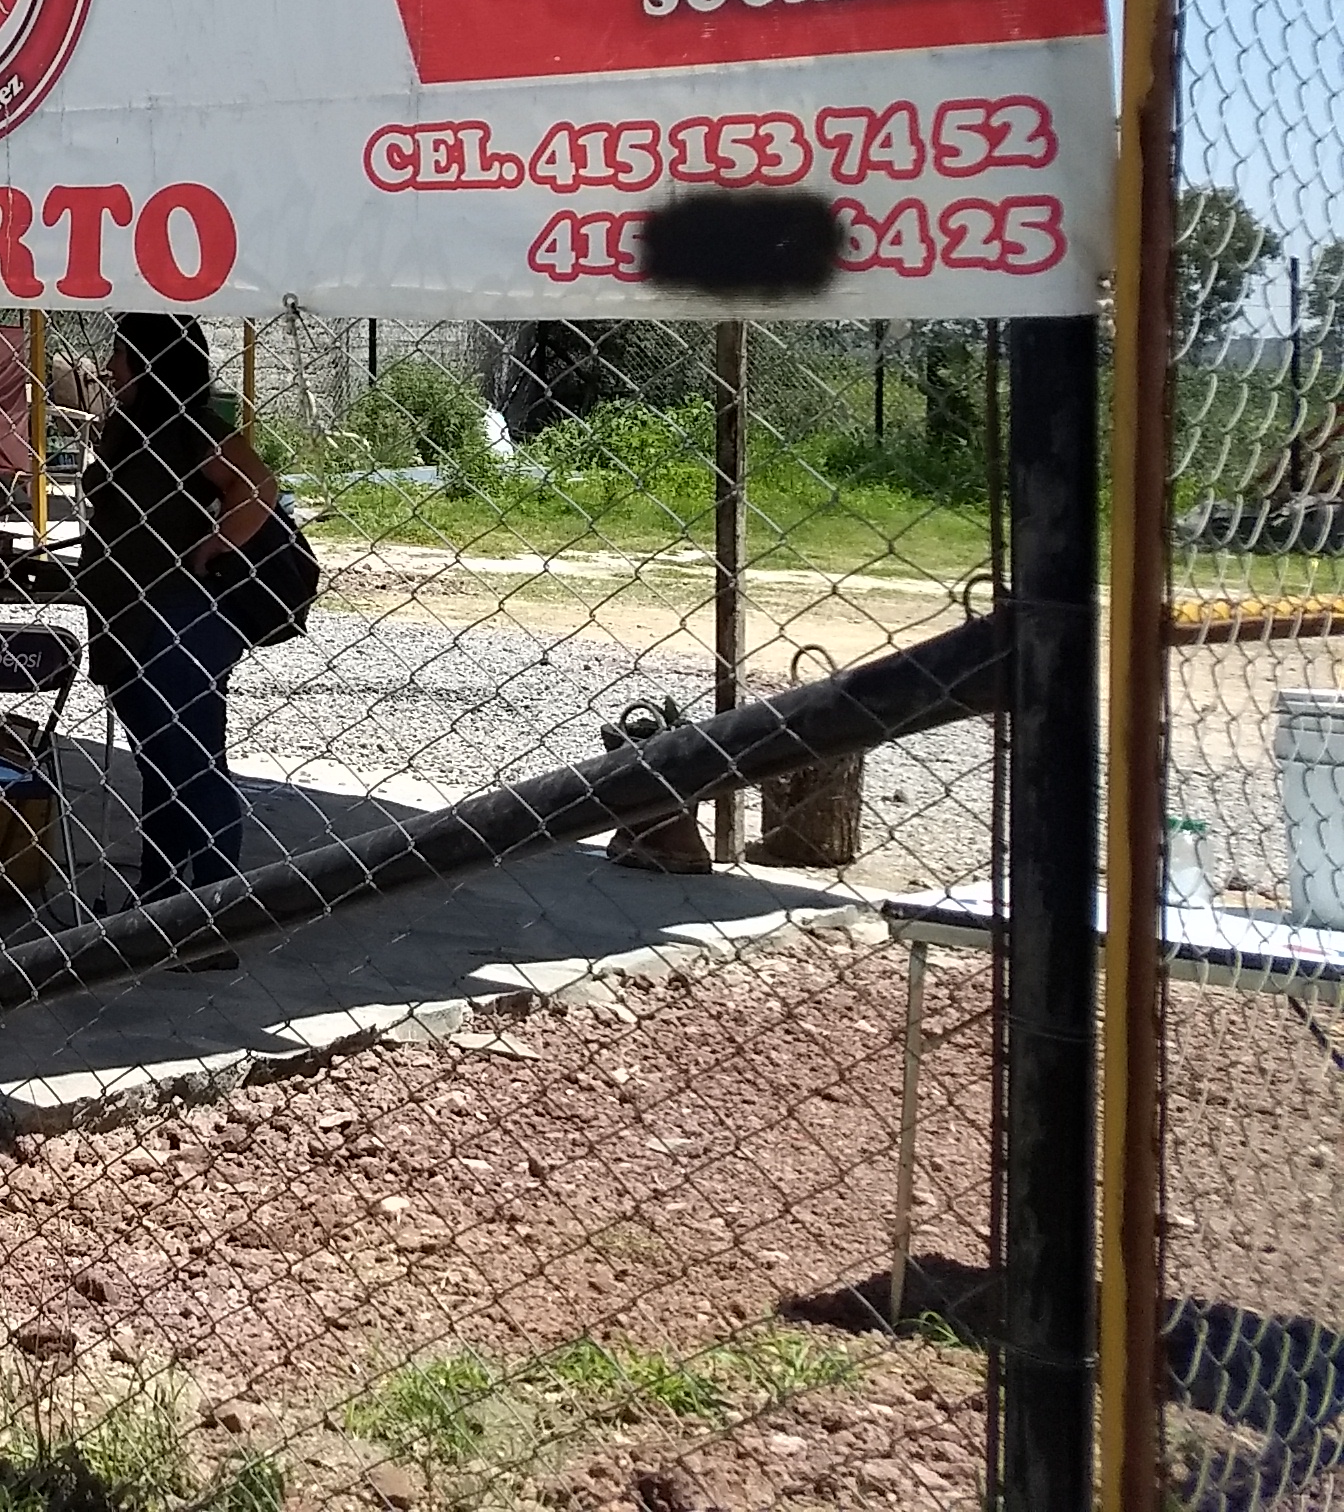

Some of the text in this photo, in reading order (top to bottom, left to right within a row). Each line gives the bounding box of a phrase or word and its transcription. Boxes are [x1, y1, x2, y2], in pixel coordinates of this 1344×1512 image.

[367, 99, 1057, 189] CEL. 415 153 74 52
[941, 199, 1064, 271] 25
